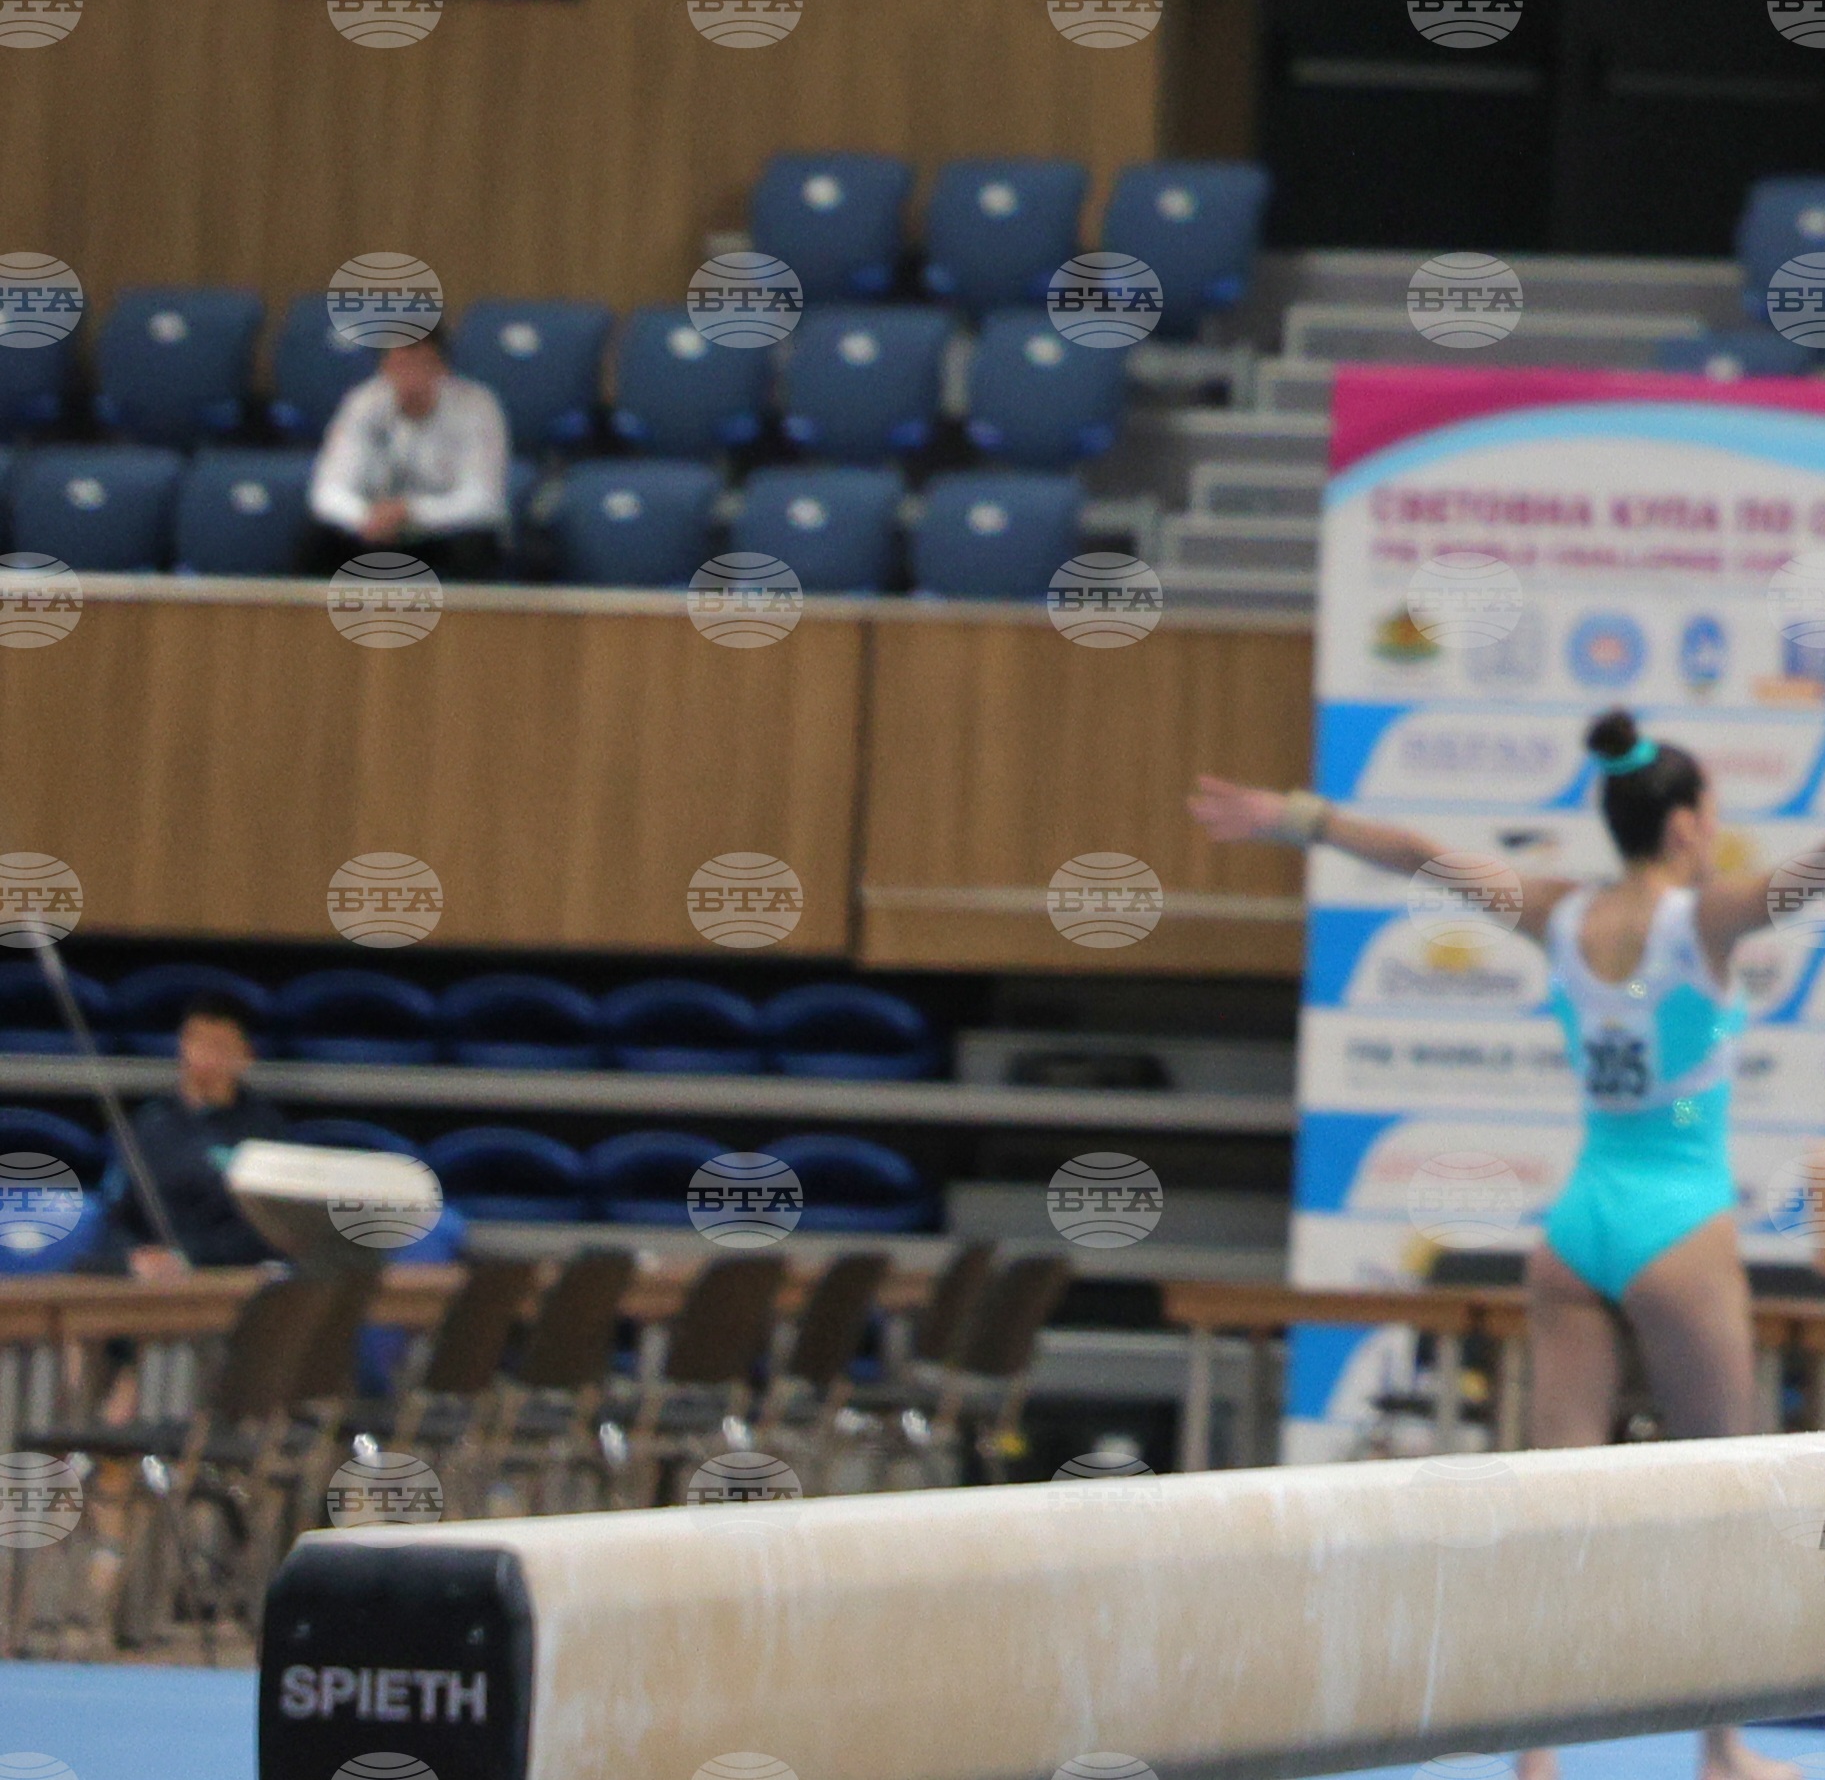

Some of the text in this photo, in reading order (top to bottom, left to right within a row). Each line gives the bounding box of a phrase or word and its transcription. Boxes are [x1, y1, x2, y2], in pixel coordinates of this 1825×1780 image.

[1370, 485, 1592, 527] СВЕТОВНА
[1610, 491, 1719, 530] КУПА
[1737, 495, 1794, 534] ПО
[280, 1663, 488, 1723] SPIETH
